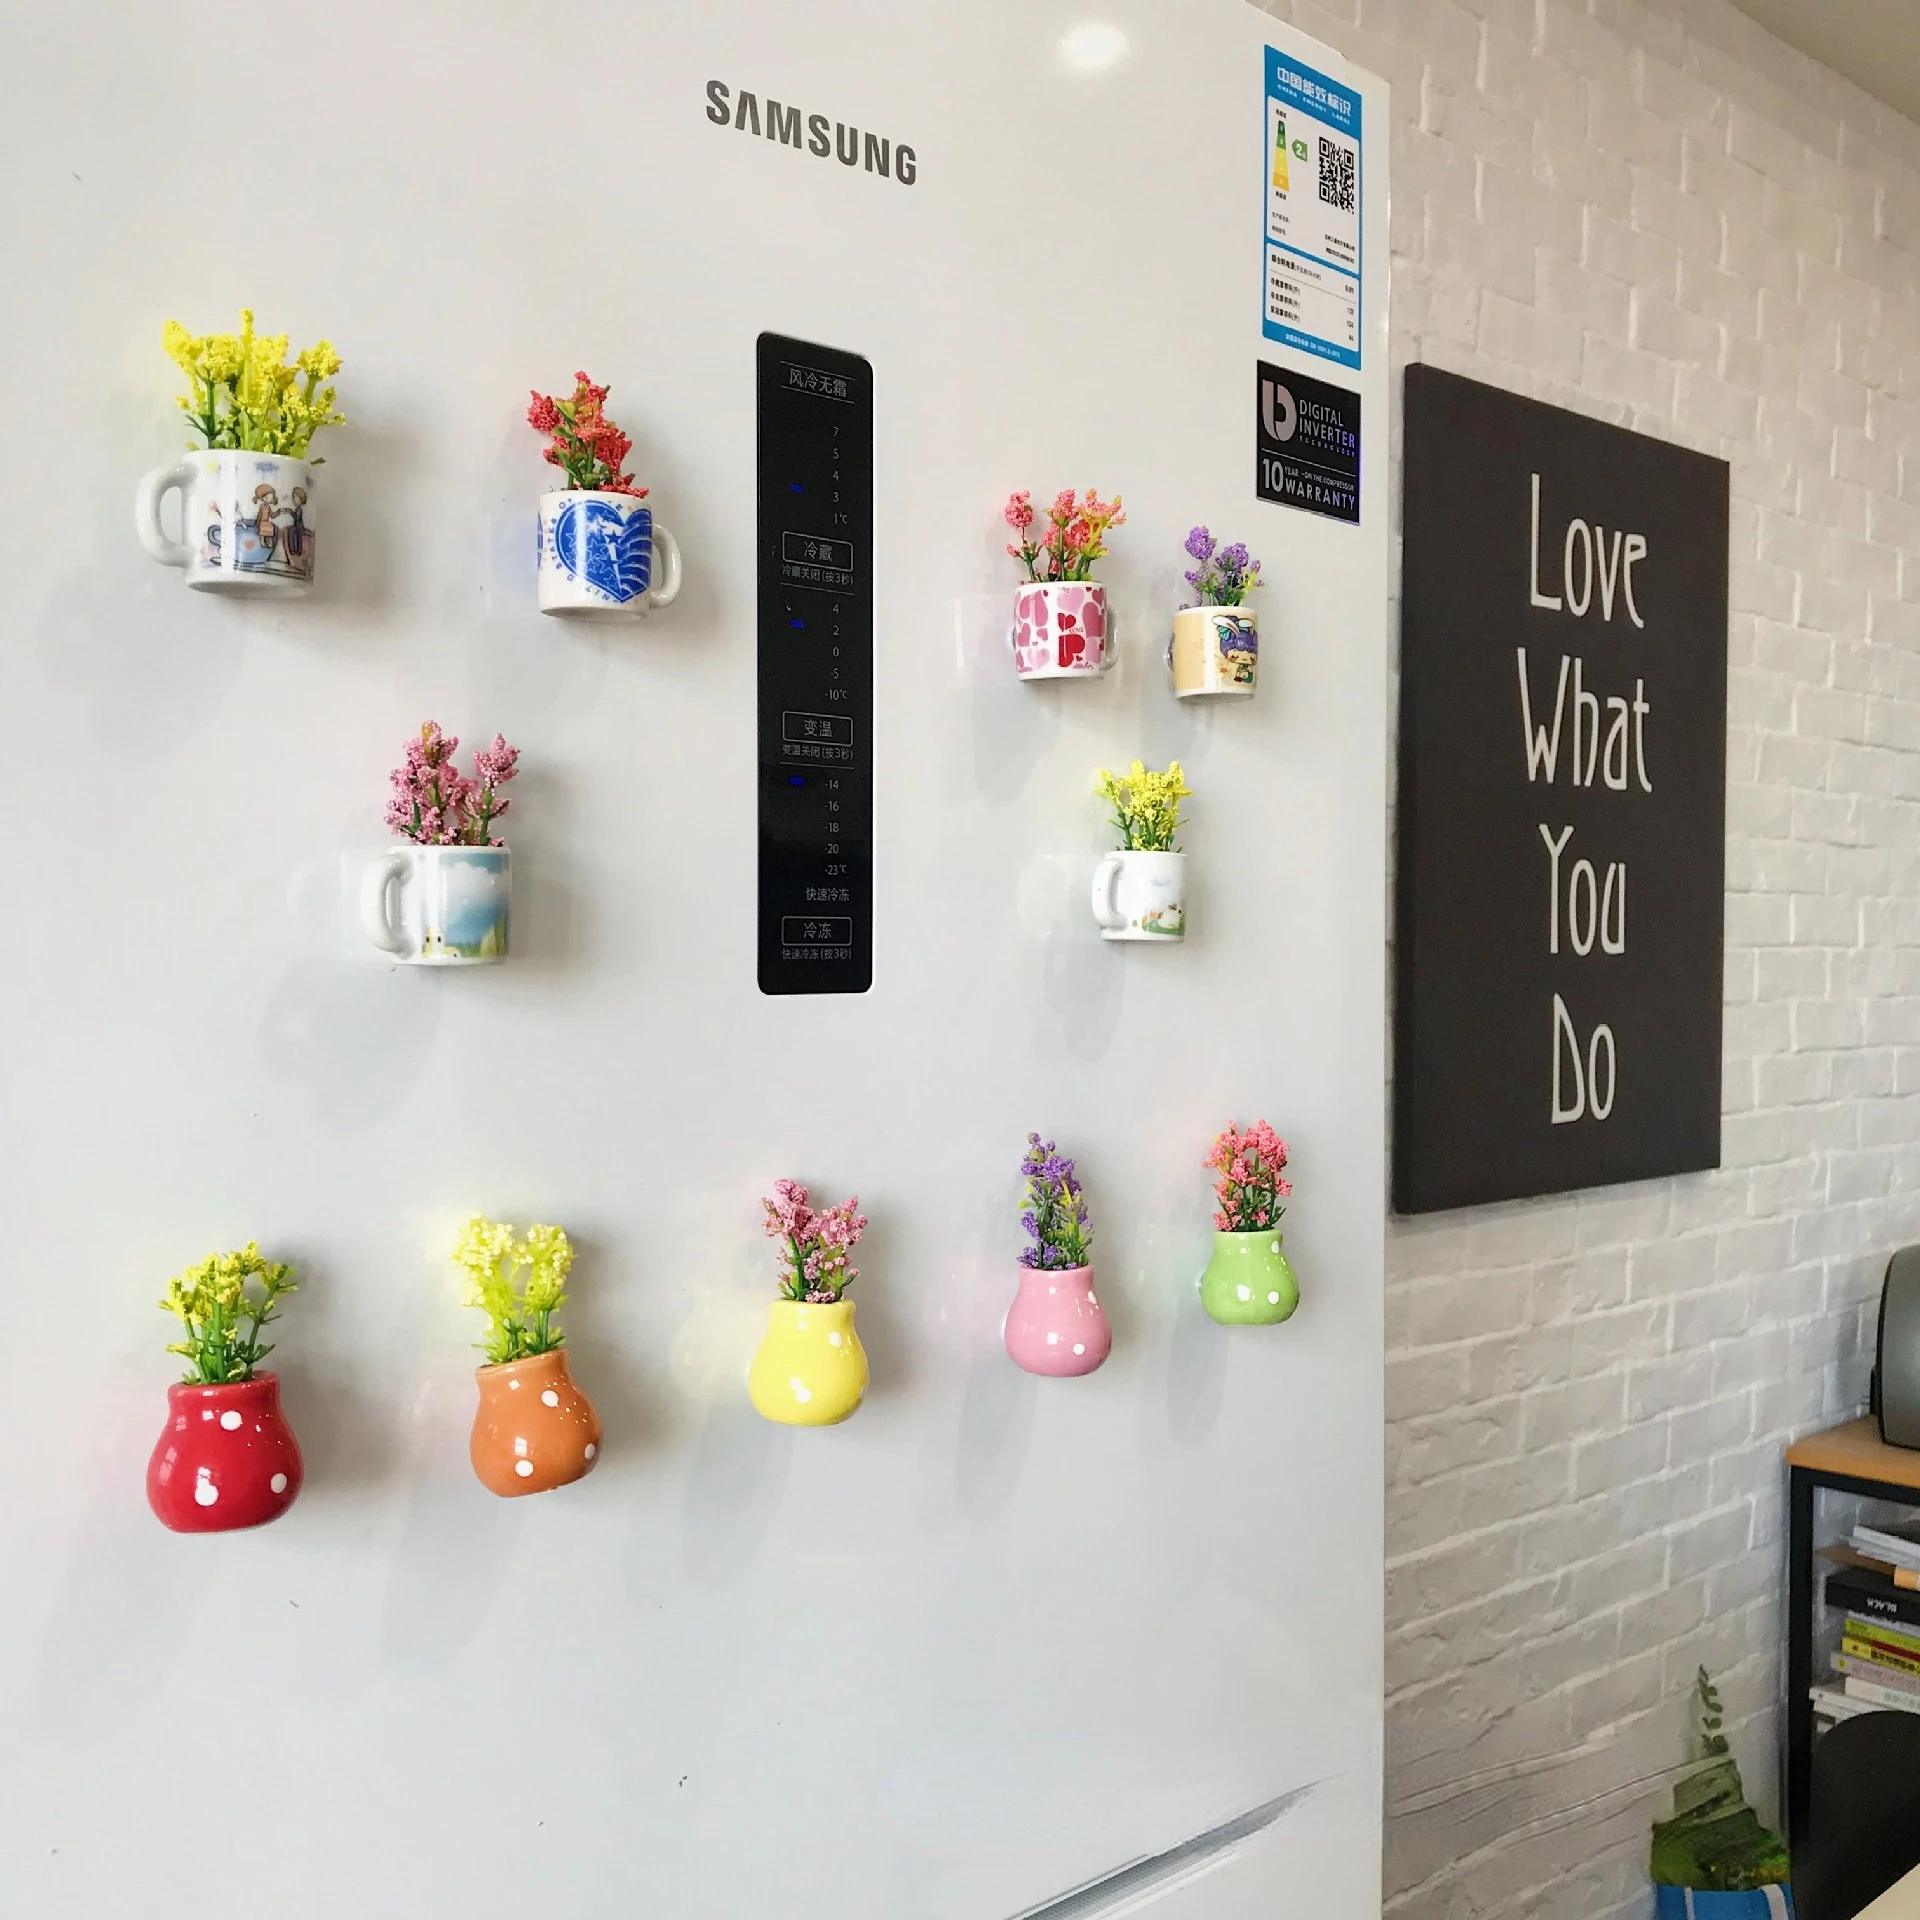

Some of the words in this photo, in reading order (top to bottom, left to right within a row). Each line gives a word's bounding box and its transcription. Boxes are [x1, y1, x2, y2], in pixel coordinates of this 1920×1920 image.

[1277, 66, 1351, 116] 中国能效标识
[1277, 84, 1297, 98] CHINA
[1331, 112, 1350, 125] LABEL
[706, 79, 916, 186] SAMSUNG
[789, 368, 847, 398] 风冷无霜
[1300, 399, 1344, 427] DIGITAL
[832, 427, 839, 436] 7
[1300, 417, 1355, 449] INVERTER
[833, 448, 839, 459] 5
[1300, 435, 1355, 458] TECHNOLOGY
[832, 471, 838, 480] 4
[1262, 458, 1284, 492] 10
[1284, 466, 1299, 477] YEAR
[1313, 474, 1323, 483] THE
[832, 492, 839, 502] 3
[1285, 477, 1355, 510] WARRANTY
[801, 542, 832, 563] 冷藏
[1529, 473, 1646, 628] Love
[832, 604, 838, 613] 4
[832, 625, 839, 635] 2
[832, 647, 839, 657] 0
[831, 668, 839, 679] -5
[803, 719, 832, 737] 变温
[1516, 647, 1652, 792] What
[825, 780, 839, 789] -14
[824, 801, 839, 811] -16
[824, 823, 839, 832] -18
[824, 844, 838, 853] -20
[805, 887, 849, 901] 快速冷冻
[1538, 824, 1625, 955] You
[803, 922, 831, 938] 冷冻
[1551, 993, 1615, 1124] Do
